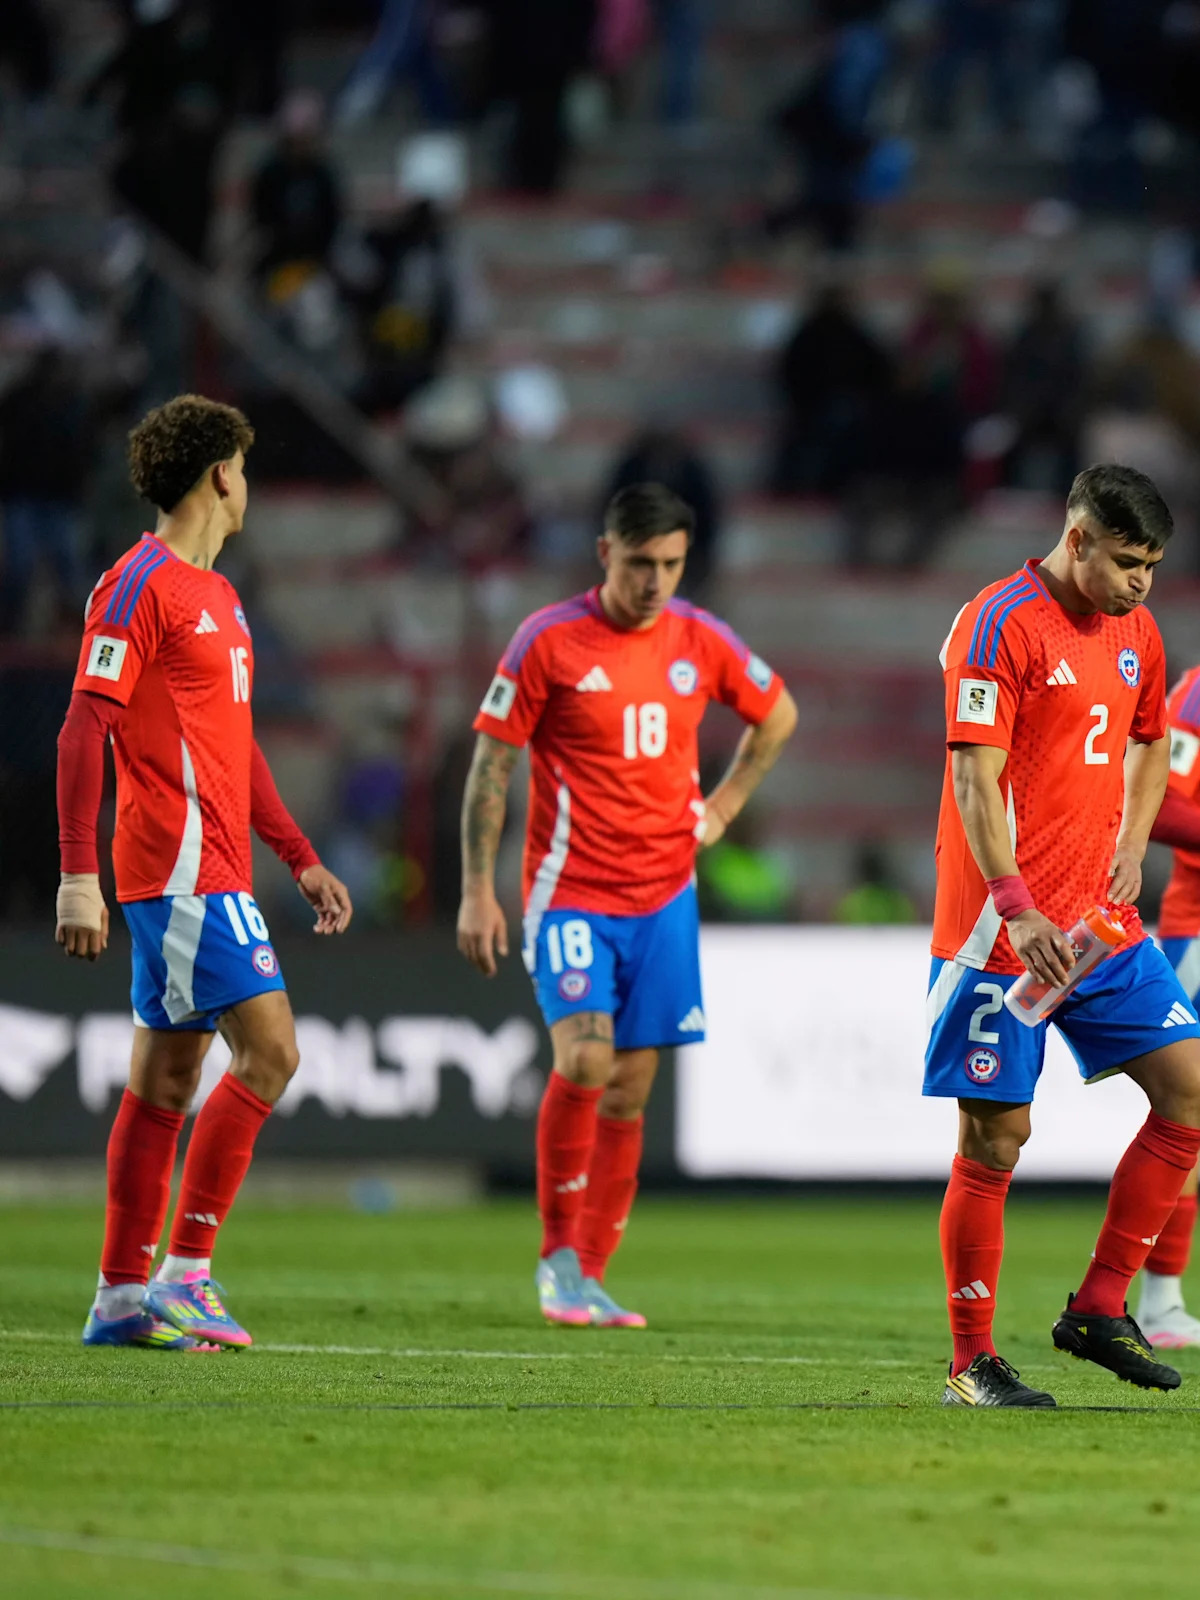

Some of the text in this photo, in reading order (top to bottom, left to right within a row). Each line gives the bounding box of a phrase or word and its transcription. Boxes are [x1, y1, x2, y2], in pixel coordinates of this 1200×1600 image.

[229, 646, 249, 703] 16
[623, 702, 668, 760] 18
[1084, 703, 1110, 765] 2
[223, 890, 269, 946] 16
[547, 918, 593, 974] 18
[968, 982, 1004, 1045] 2
[76, 1012, 540, 1119] PALTY
